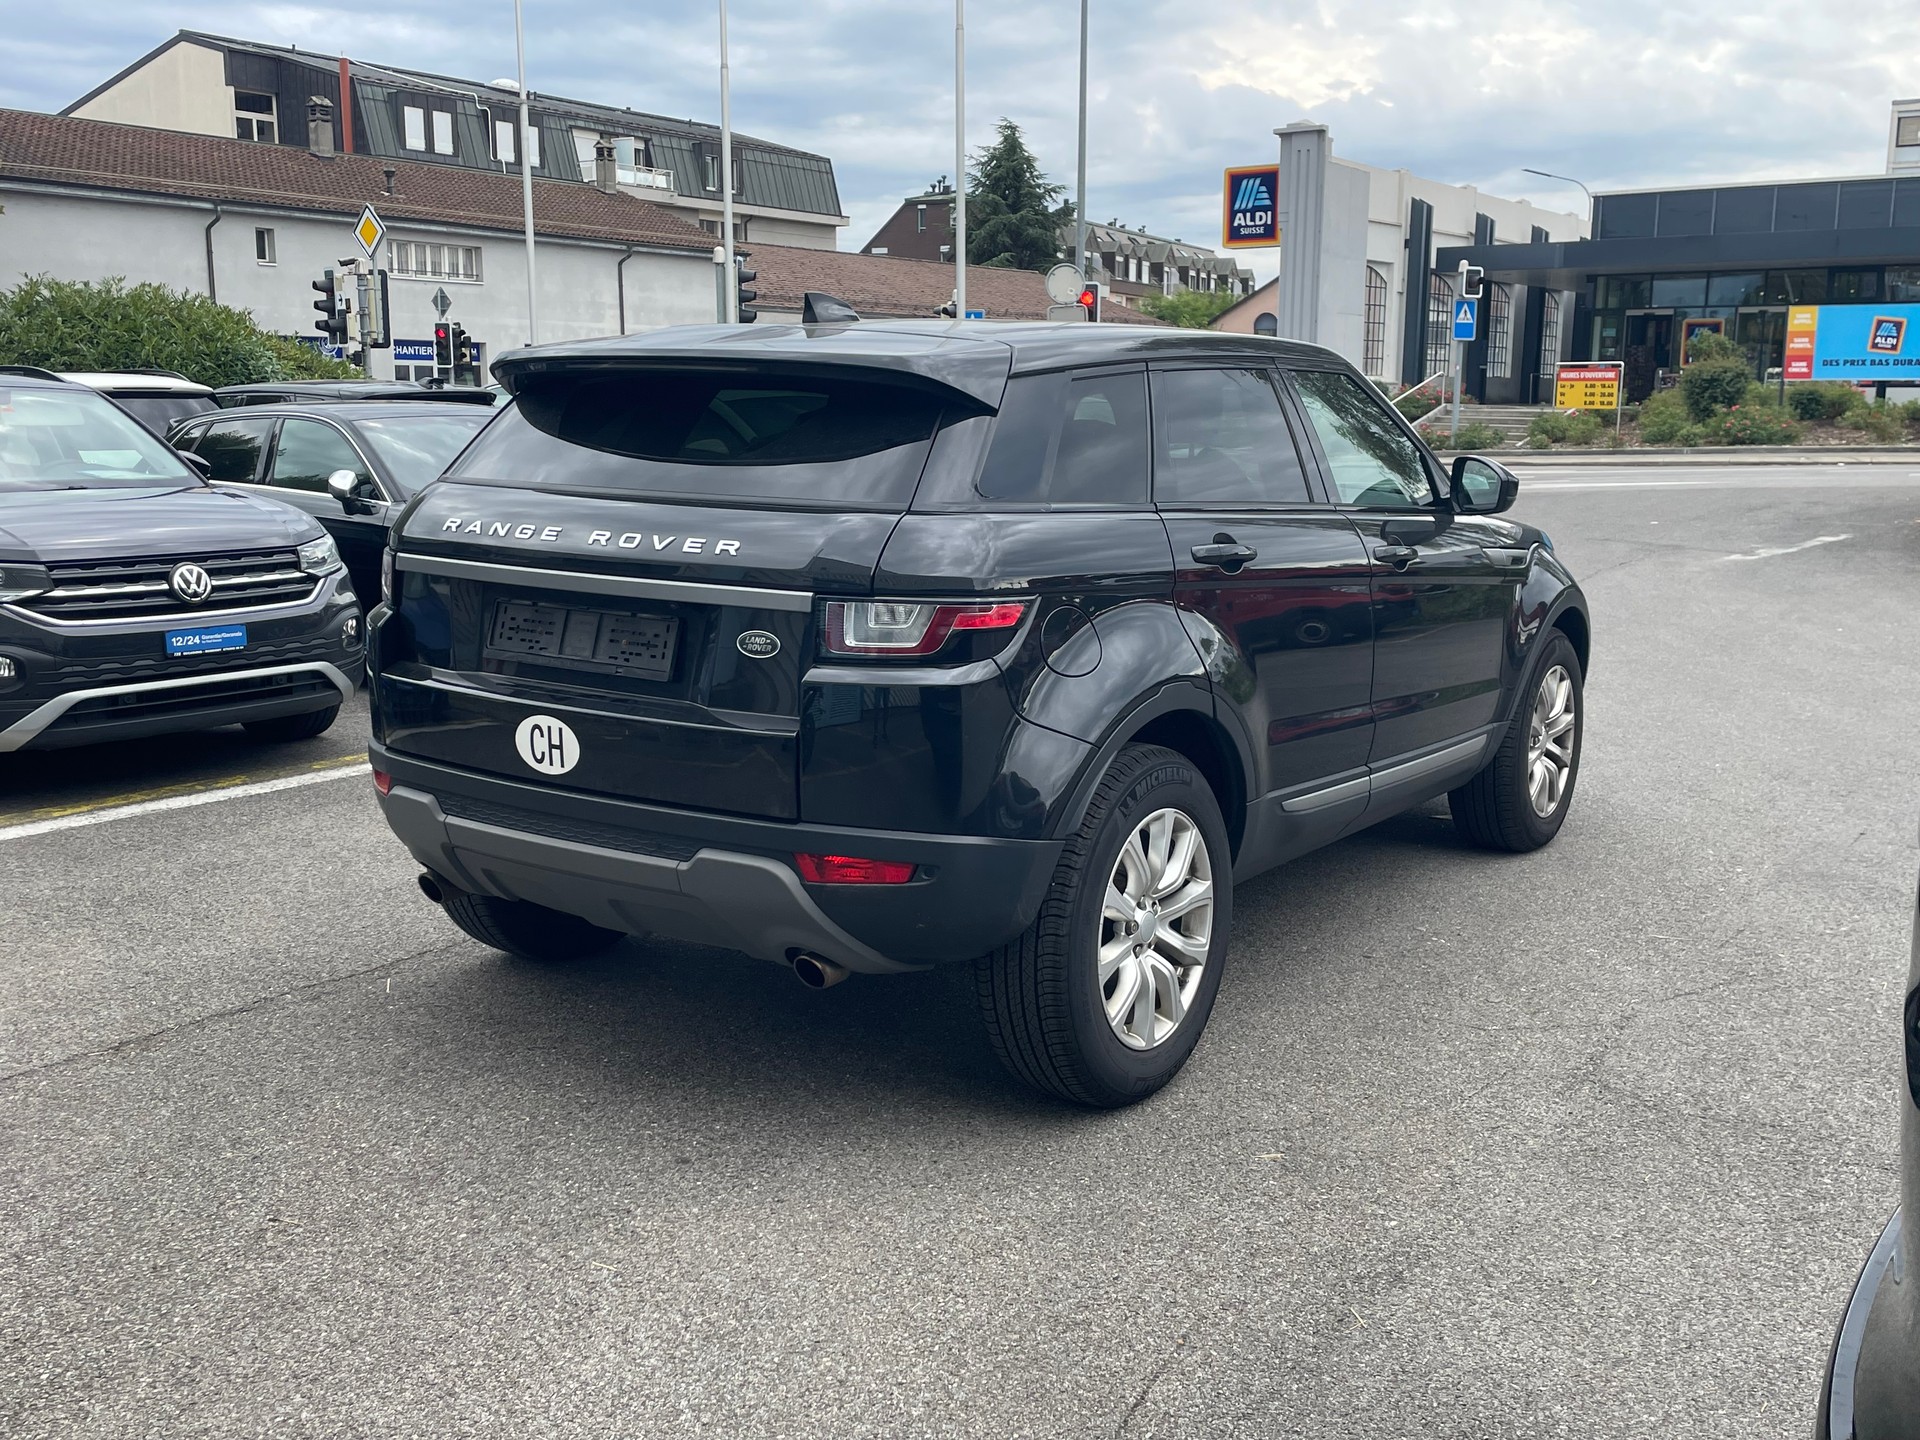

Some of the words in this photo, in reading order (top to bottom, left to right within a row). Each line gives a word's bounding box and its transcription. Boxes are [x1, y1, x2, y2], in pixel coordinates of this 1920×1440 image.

[1233, 211, 1272, 226] ALDI
[1240, 226, 1265, 235] SUISSE
[1874, 336, 1897, 346] ALDI
[1822, 359, 1839, 367] DES
[1843, 359, 1867, 367] PRIX
[1870, 359, 1890, 367] BAS
[1560, 371, 1580, 379] HEURES
[442, 518, 563, 542] RANGE
[587, 529, 742, 556] ROVER
[173, 564, 211, 600] VW
[171, 635, 201, 647] 12/24
[530, 723, 565, 769] CH
[1134, 766, 1192, 800] MICHELIN
